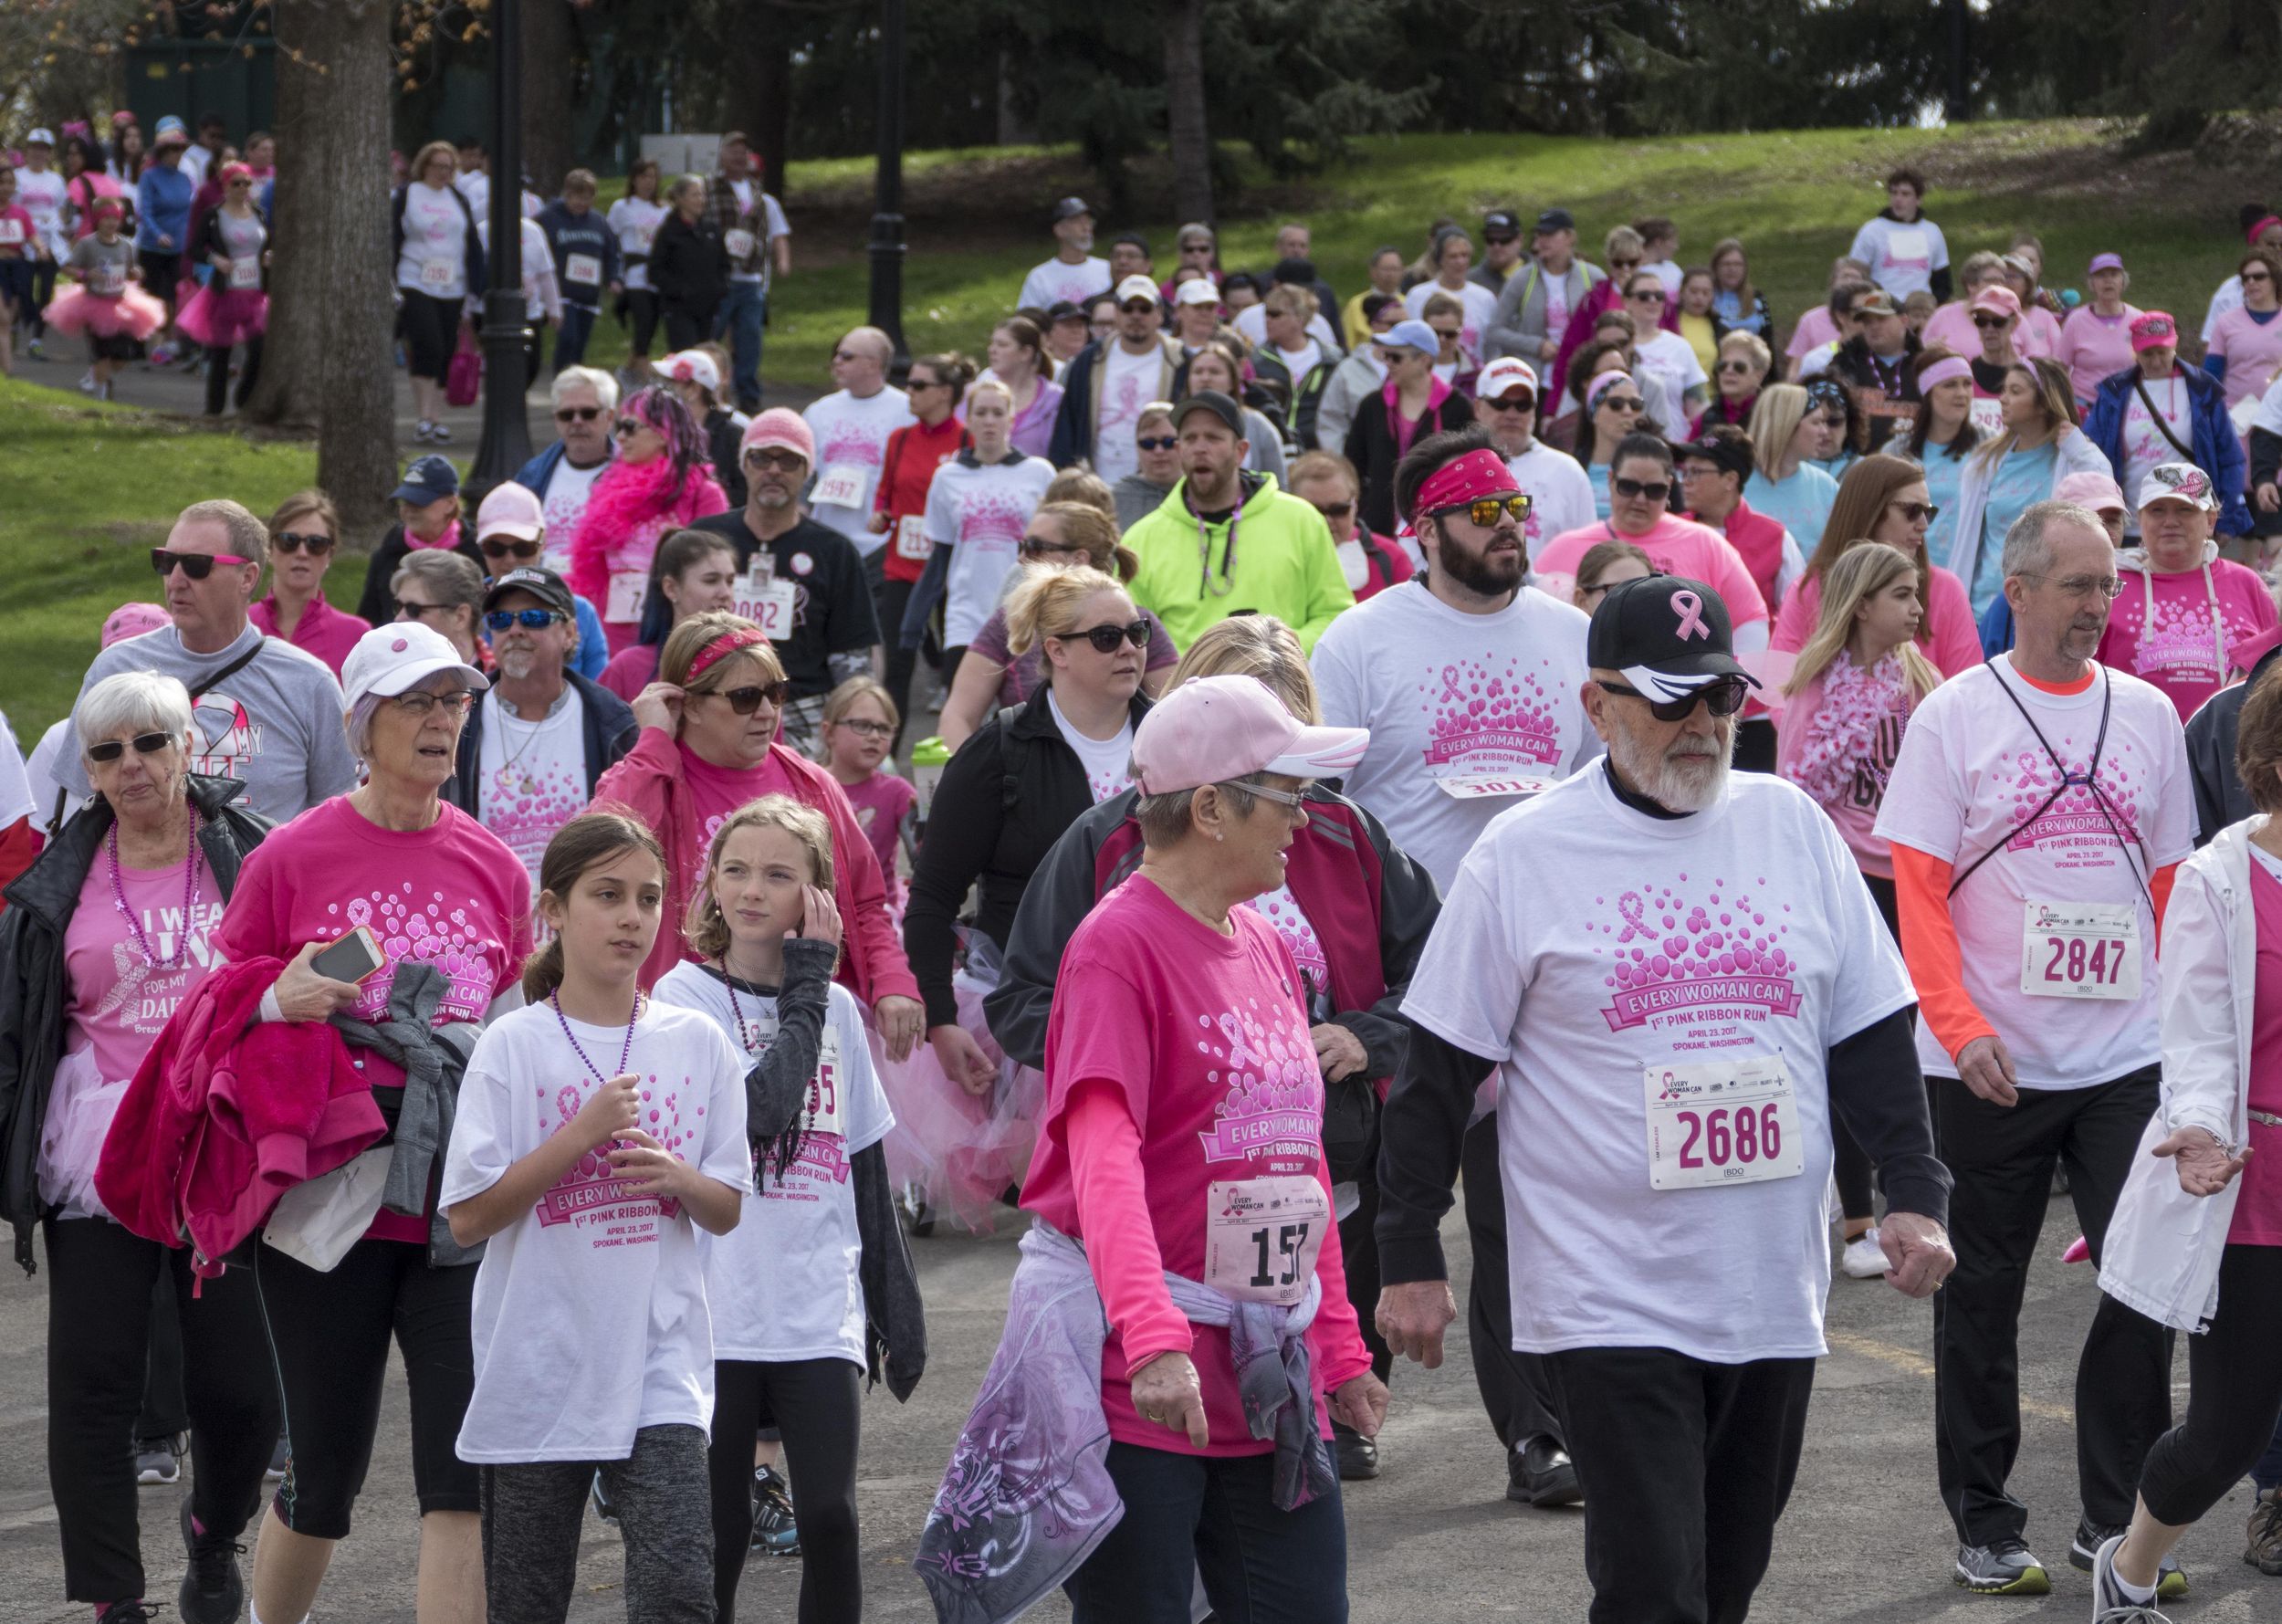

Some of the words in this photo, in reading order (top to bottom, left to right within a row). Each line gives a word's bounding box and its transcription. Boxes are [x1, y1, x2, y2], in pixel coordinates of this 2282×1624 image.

[2178, 649, 2213, 659] WOMAN
[2183, 661, 2208, 669] RIBBON
[234, 723, 263, 755] MY
[1440, 737, 1476, 755] EVERY
[1478, 734, 1523, 749] WOMAN
[1525, 739, 1549, 754] CAN
[1463, 754, 1481, 763] PINK
[1482, 752, 1514, 763] RIBBON
[1516, 756, 1534, 767] RUN
[2022, 818, 2062, 839] EVERY
[2115, 821, 2134, 835] CA
[2038, 841, 2049, 853] 1ST
[2051, 839, 2073, 850] PINK
[2074, 837, 2107, 847] RIBBON
[2067, 851, 2082, 859] APRIL
[2092, 851, 2104, 859] 2017
[143, 909, 152, 933] I
[159, 902, 225, 932] WEA
[2045, 938, 2126, 984] 2847
[143, 979, 168, 995] FOR
[170, 973, 187, 989] MY
[460, 985, 484, 1004] CAN
[1628, 987, 1681, 1014] EVERY
[1685, 981, 1750, 1002] WOMAN
[1753, 982, 1785, 1002] CAN
[448, 1006, 470, 1020] RUN
[1651, 1016, 1665, 1031] 1ST
[1668, 1012, 1695, 1027] PINK
[1698, 1009, 1742, 1022] RIBBON
[1744, 1010, 1766, 1022] RUN
[1688, 1029, 1708, 1038] APRIL
[1722, 1027, 1737, 1036] 2017
[1709, 1037, 1755, 1048] WASHINGTON
[1231, 1118, 1276, 1144] EVERY
[1677, 1103, 1781, 1168] 2686
[1247, 1148, 1260, 1162] 1ST
[1276, 1142, 1310, 1158] RIBBON
[814, 1169, 831, 1183] RUN
[1271, 1163, 1286, 1172] APRIL
[556, 1184, 605, 1211] EVERY
[786, 1192, 820, 1201] WASHINGTON
[575, 1215, 588, 1229] 1ST
[590, 1210, 616, 1226] PINK
[618, 1205, 659, 1219] RIBBON
[607, 1225, 626, 1235] APRIL
[639, 1223, 654, 1232] 2017
